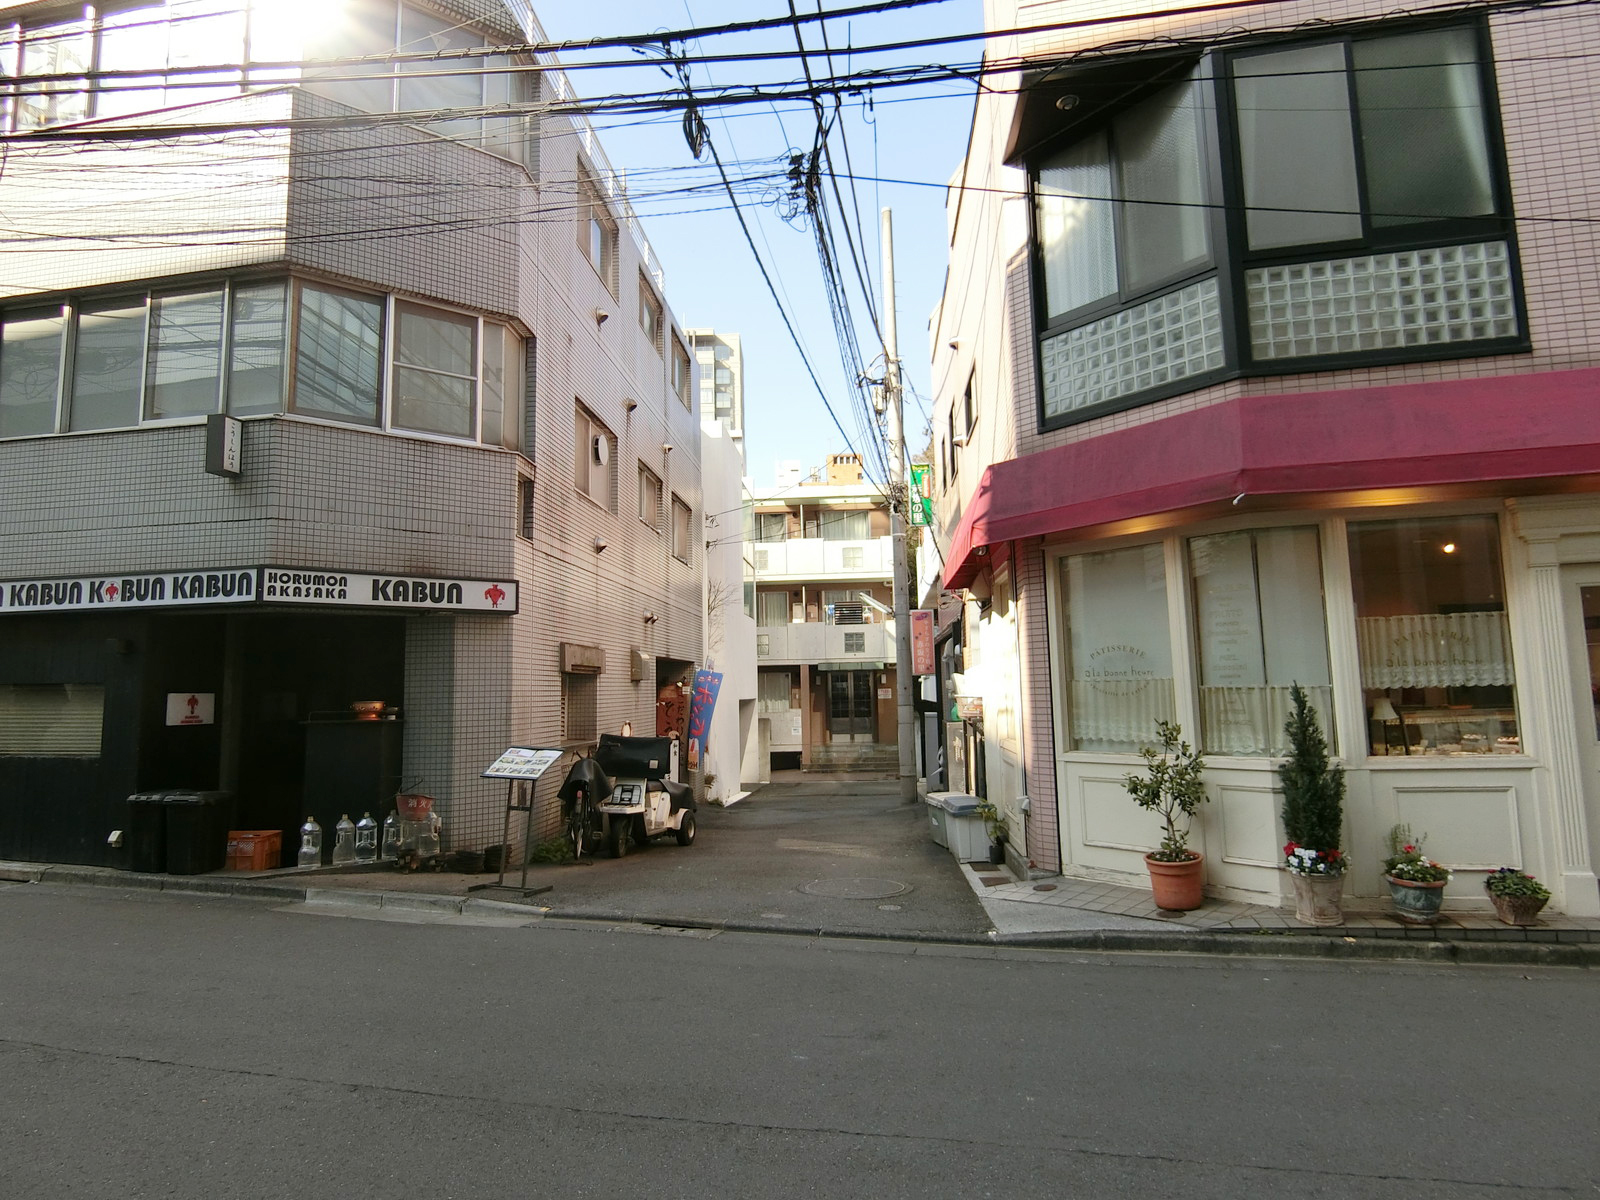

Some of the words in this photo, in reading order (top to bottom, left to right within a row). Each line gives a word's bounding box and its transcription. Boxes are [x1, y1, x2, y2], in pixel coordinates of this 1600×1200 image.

[268, 572, 348, 587] HORUMON
[9, 581, 83, 607] KABUN
[172, 571, 253, 600] KABUN
[266, 585, 347, 600] AKASAKA
[371, 578, 463, 605] KABUN
[1104, 666, 1127, 677] bonne
[1131, 666, 1154, 677] heure
